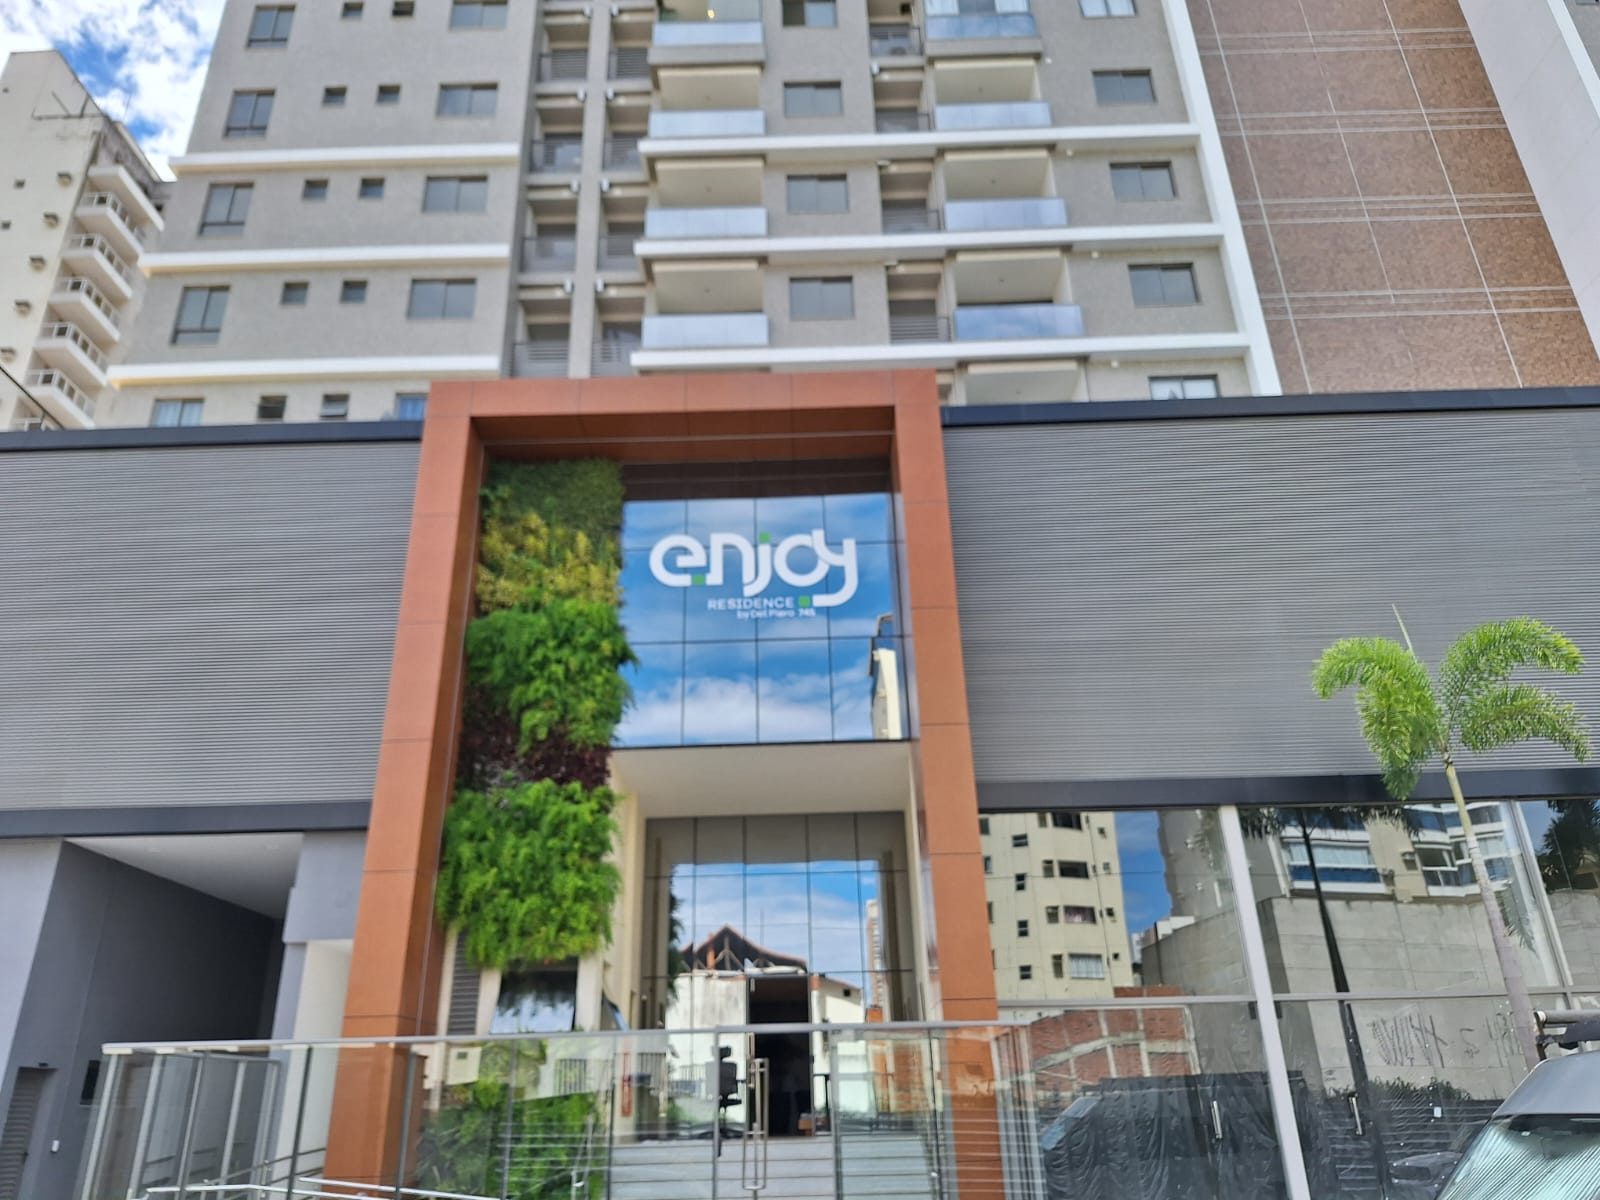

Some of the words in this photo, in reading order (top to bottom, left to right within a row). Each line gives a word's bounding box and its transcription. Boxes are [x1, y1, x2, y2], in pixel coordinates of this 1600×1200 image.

[649, 528, 858, 607] enjoy
[707, 597, 794, 611] RESIDENCE
[737, 610, 750, 620] by
